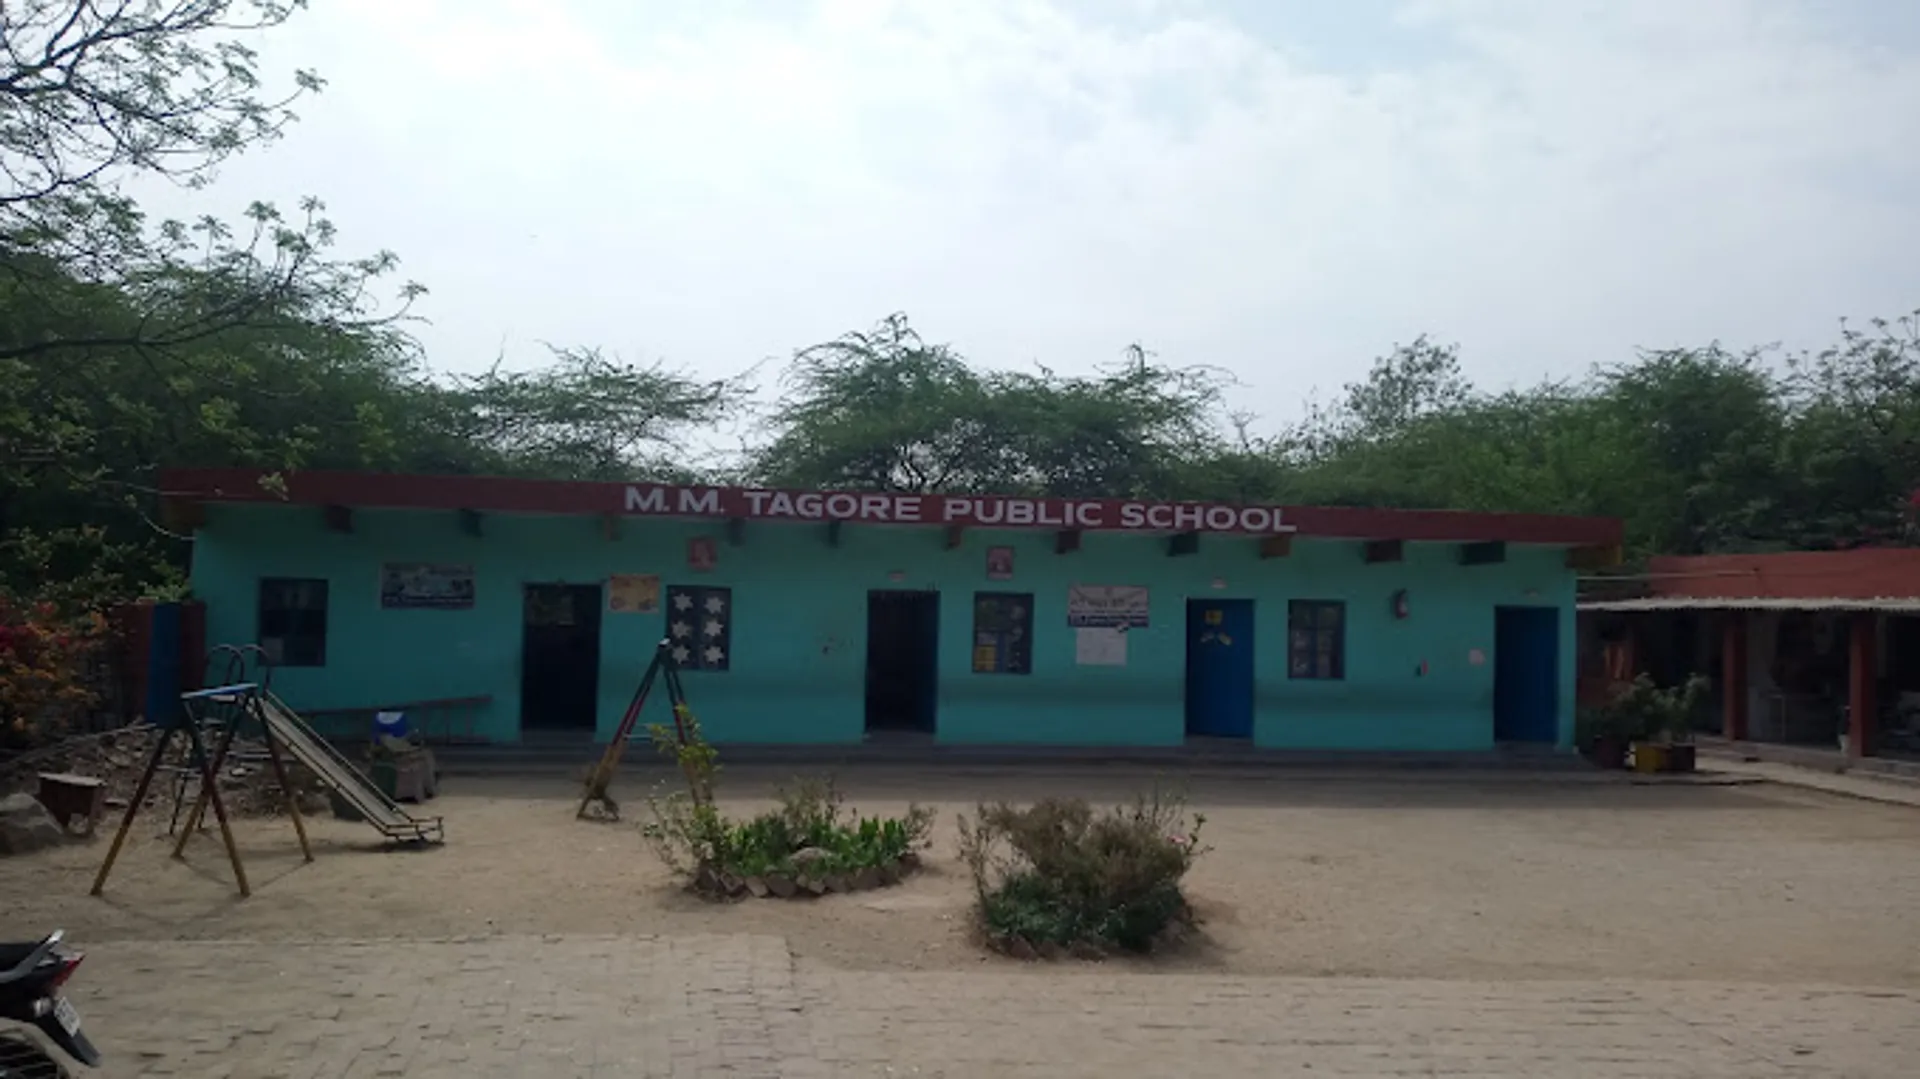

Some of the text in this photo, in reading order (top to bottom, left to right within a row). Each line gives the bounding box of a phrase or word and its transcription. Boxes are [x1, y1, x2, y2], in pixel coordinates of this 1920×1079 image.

[742, 490, 922, 522] TAGORE
[942, 498, 1103, 527] PUBLIC
[1120, 503, 1298, 533] SCHOOL
